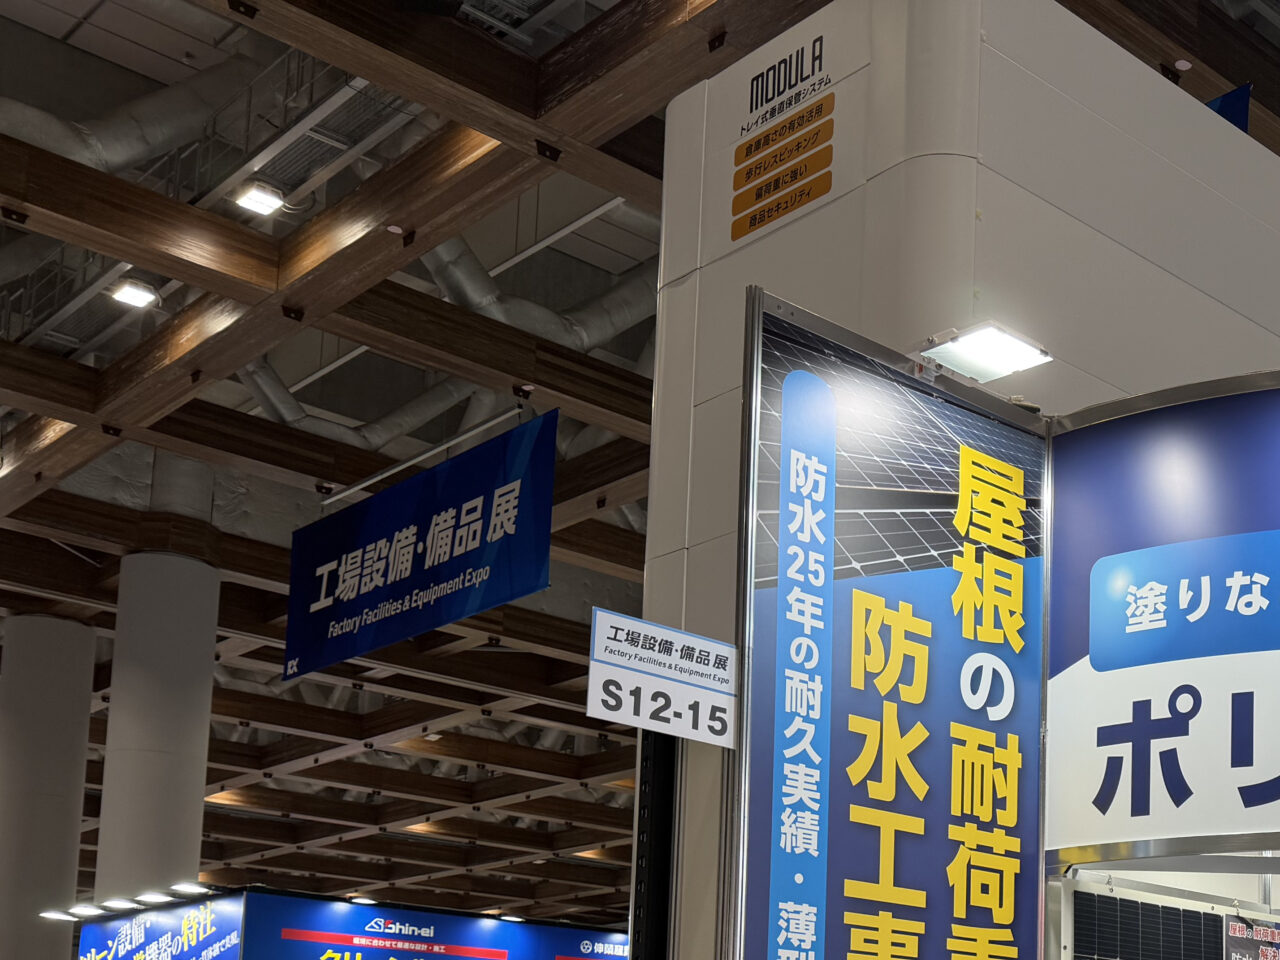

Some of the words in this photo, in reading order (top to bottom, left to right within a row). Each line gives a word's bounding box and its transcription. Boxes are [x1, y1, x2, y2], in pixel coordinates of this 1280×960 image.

[750, 35, 823, 114] MODULA
[740, 74, 832, 137] トレイ式垂直保管システム
[744, 103, 824, 159] 倉庫高さの有効活用
[328, 611, 362, 638] Factory
[362, 594, 401, 626] Facilities
[402, 596, 411, 610] &
[411, 576, 466, 609] Equipment
[464, 565, 490, 589] Expo
[604, 645, 633, 661] Factory
[633, 653, 667, 669] Facilities
[674, 663, 712, 680] Equipment
[713, 674, 730, 685] Expo
[601, 678, 728, 737] S12-15
